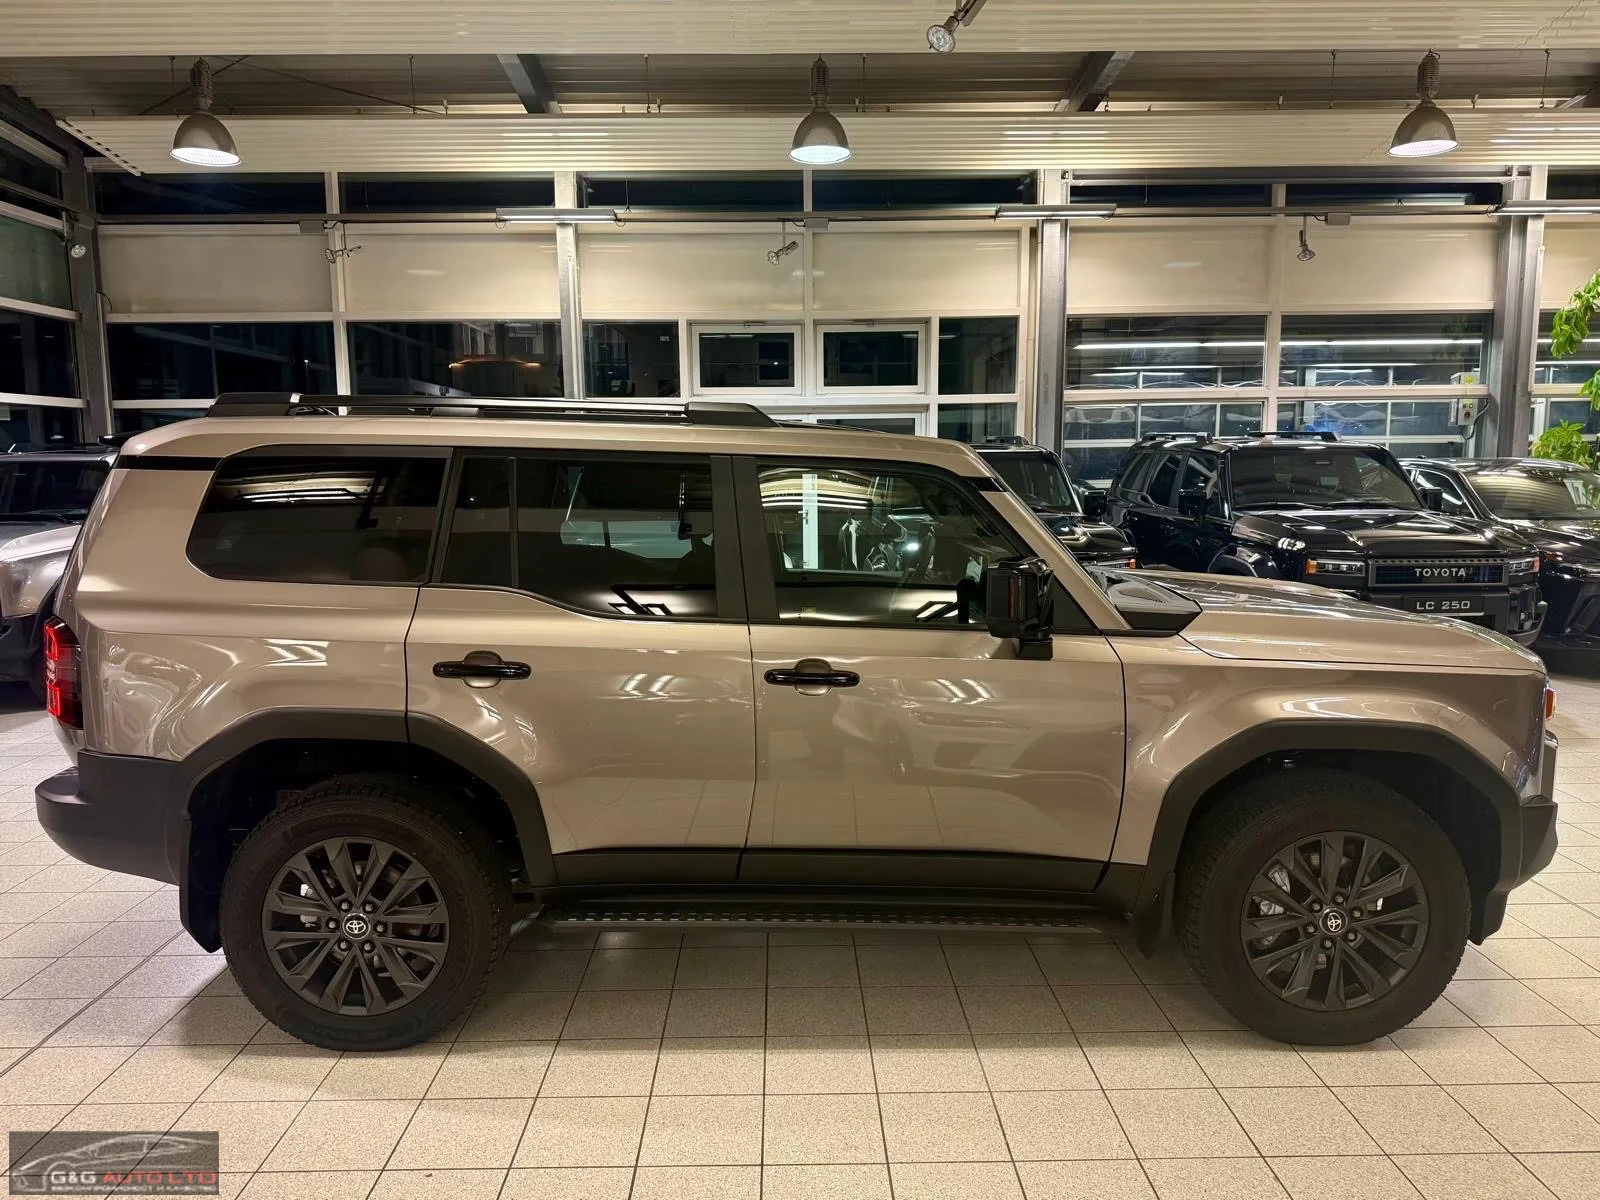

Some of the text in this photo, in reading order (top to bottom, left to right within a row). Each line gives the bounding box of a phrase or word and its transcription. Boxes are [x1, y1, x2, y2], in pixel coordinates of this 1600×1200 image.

[1414, 568, 1467, 577] TOYOTA
[1416, 600, 1471, 610] LC 250
